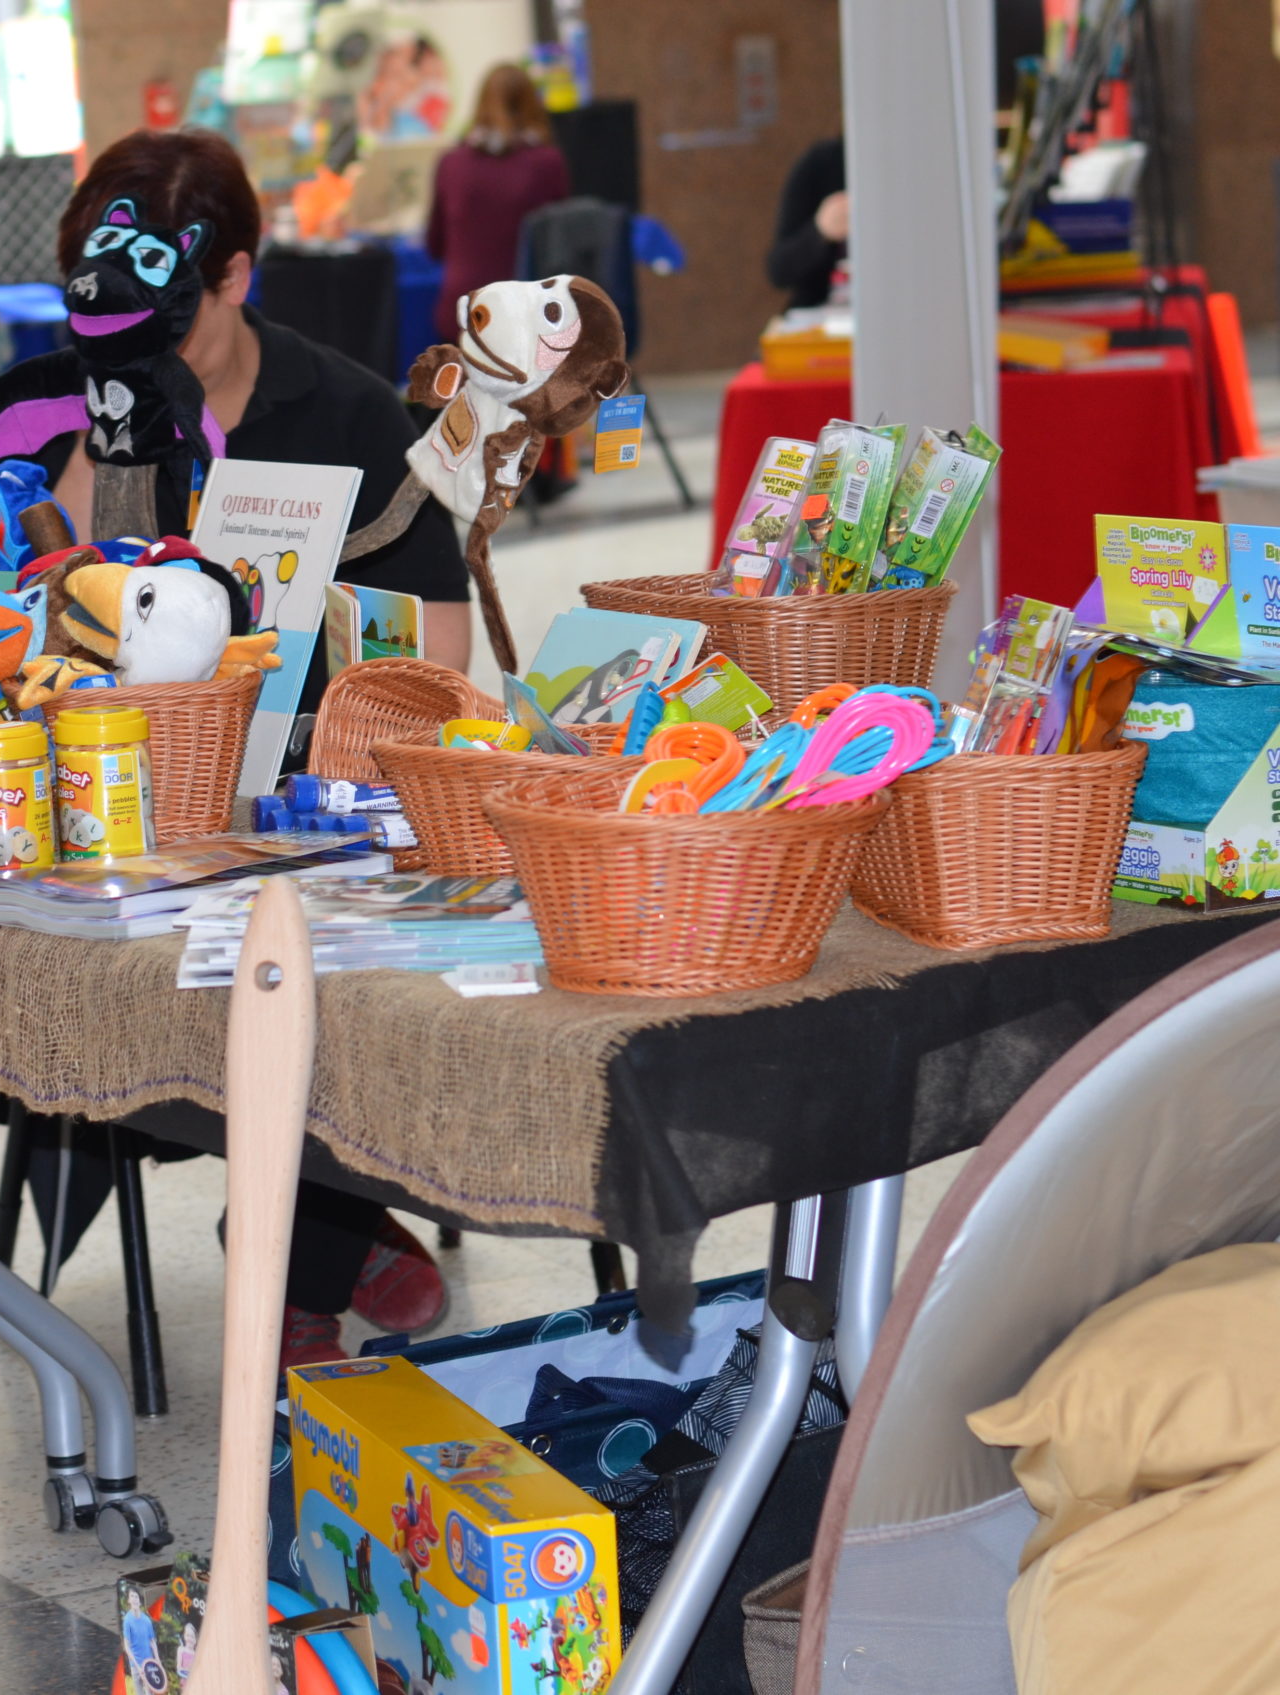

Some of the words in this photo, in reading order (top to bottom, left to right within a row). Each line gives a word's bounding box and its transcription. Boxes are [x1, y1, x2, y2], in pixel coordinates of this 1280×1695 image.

[780, 452, 803, 462] WILD
[762, 475, 803, 491] NATURE
[765, 485, 792, 497] TUBE
[222, 494, 279, 517] OJIBWAY
[280, 498, 322, 520] CLANS
[271, 527, 284, 538] and
[1131, 568, 1169, 588] Spring
[1171, 571, 1194, 590] Lily
[1126, 708, 1182, 727] mers!
[104, 772, 133, 784] DOOR
[1123, 847, 1160, 865] eggie
[1146, 866, 1159, 879] Kit
[502, 1540, 528, 1599] 5047
